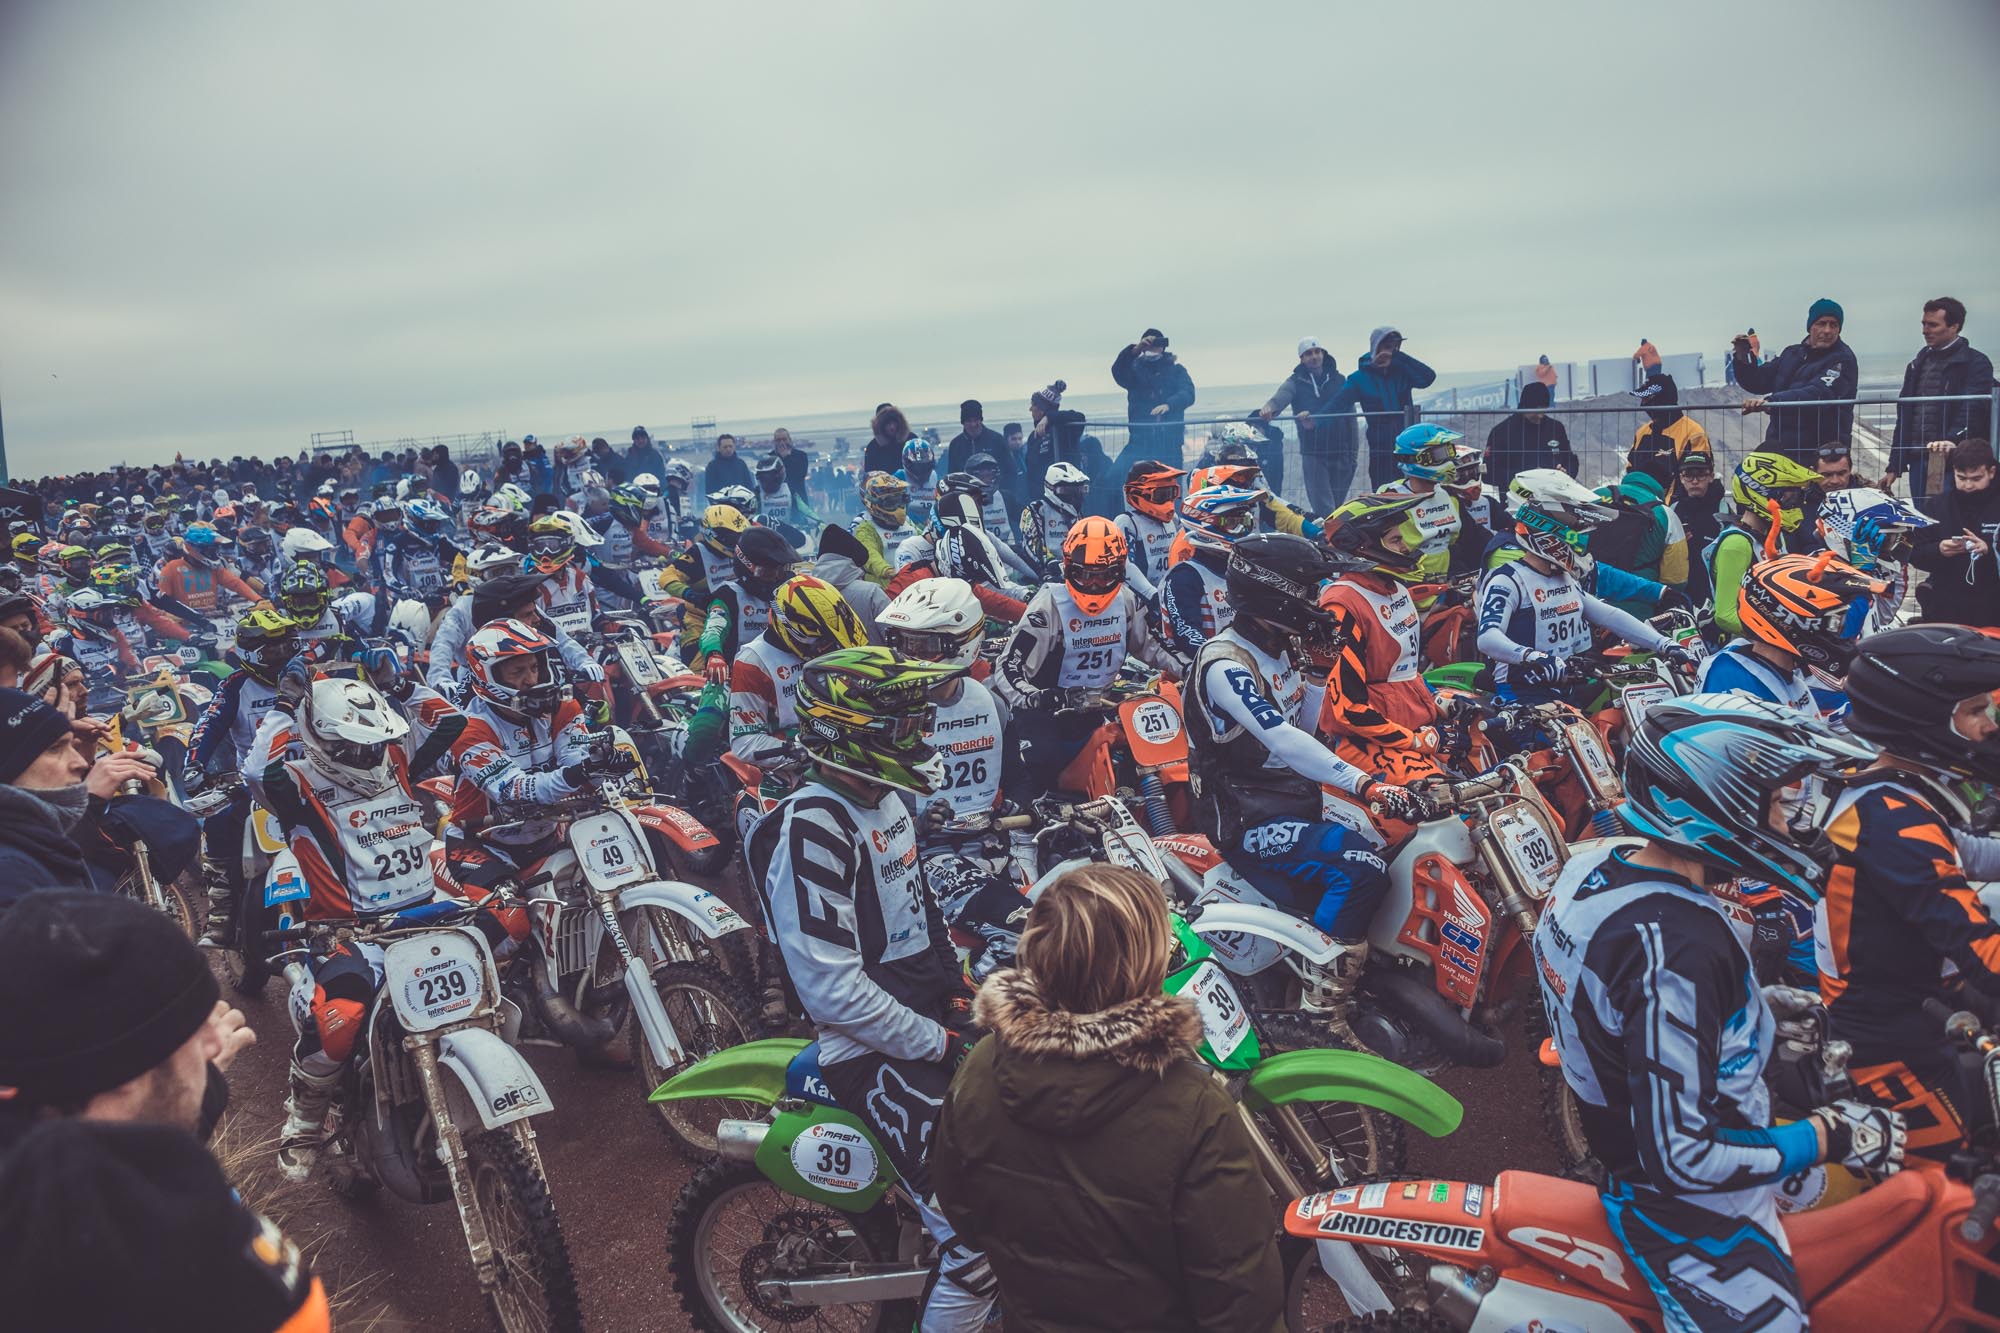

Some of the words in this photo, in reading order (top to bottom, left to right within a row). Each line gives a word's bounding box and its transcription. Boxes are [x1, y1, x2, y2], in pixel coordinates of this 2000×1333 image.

[1738, 472, 1770, 497] 100%
[1425, 503, 1450, 514] MASH
[419, 575, 438, 587] 108
[1547, 585, 1572, 598] MASH
[546, 602, 586, 617] SCOTT
[1389, 594, 1410, 613] MASH
[562, 618, 587, 627] MASH
[889, 612, 908, 621] BELL
[1084, 616, 1121, 629] MASH
[1072, 632, 1122, 647] Intermarché
[1548, 617, 1575, 644] 361
[180, 649, 197, 660] 469
[1076, 648, 1113, 671] 251
[1224, 668, 1286, 731] FIRST
[813, 720, 837, 739] SHOEI
[937, 714, 990, 732] MASH
[1141, 712, 1170, 734] 251
[370, 803, 422, 820] MASH
[1329, 810, 1352, 824] MASH
[884, 814, 910, 842] MASH
[1243, 821, 1310, 854] FIRST
[1521, 827, 1539, 840] MASH
[360, 839, 383, 849] CUCQ
[1152, 840, 1209, 859] DUNLOP
[1259, 843, 1294, 860] RACING
[1523, 837, 1554, 870] 392
[374, 845, 424, 881] 239
[603, 845, 624, 867] 49
[1343, 849, 1388, 874] FIRST
[884, 868, 906, 885] CUCQ
[1443, 910, 1483, 939] HONDA
[1440, 919, 1482, 957] CR
[425, 959, 457, 974] MASH
[1441, 942, 1478, 976] HRC
[418, 970, 467, 1007] 239
[1199, 968, 1216, 990] MASH
[1207, 983, 1236, 1022] 39
[493, 1090, 520, 1112] elf
[824, 1130, 861, 1144] MASH
[816, 1143, 851, 1176] 39
[1321, 1212, 1483, 1249] BRIDGESTONE
[1508, 1226, 1631, 1292] CR
